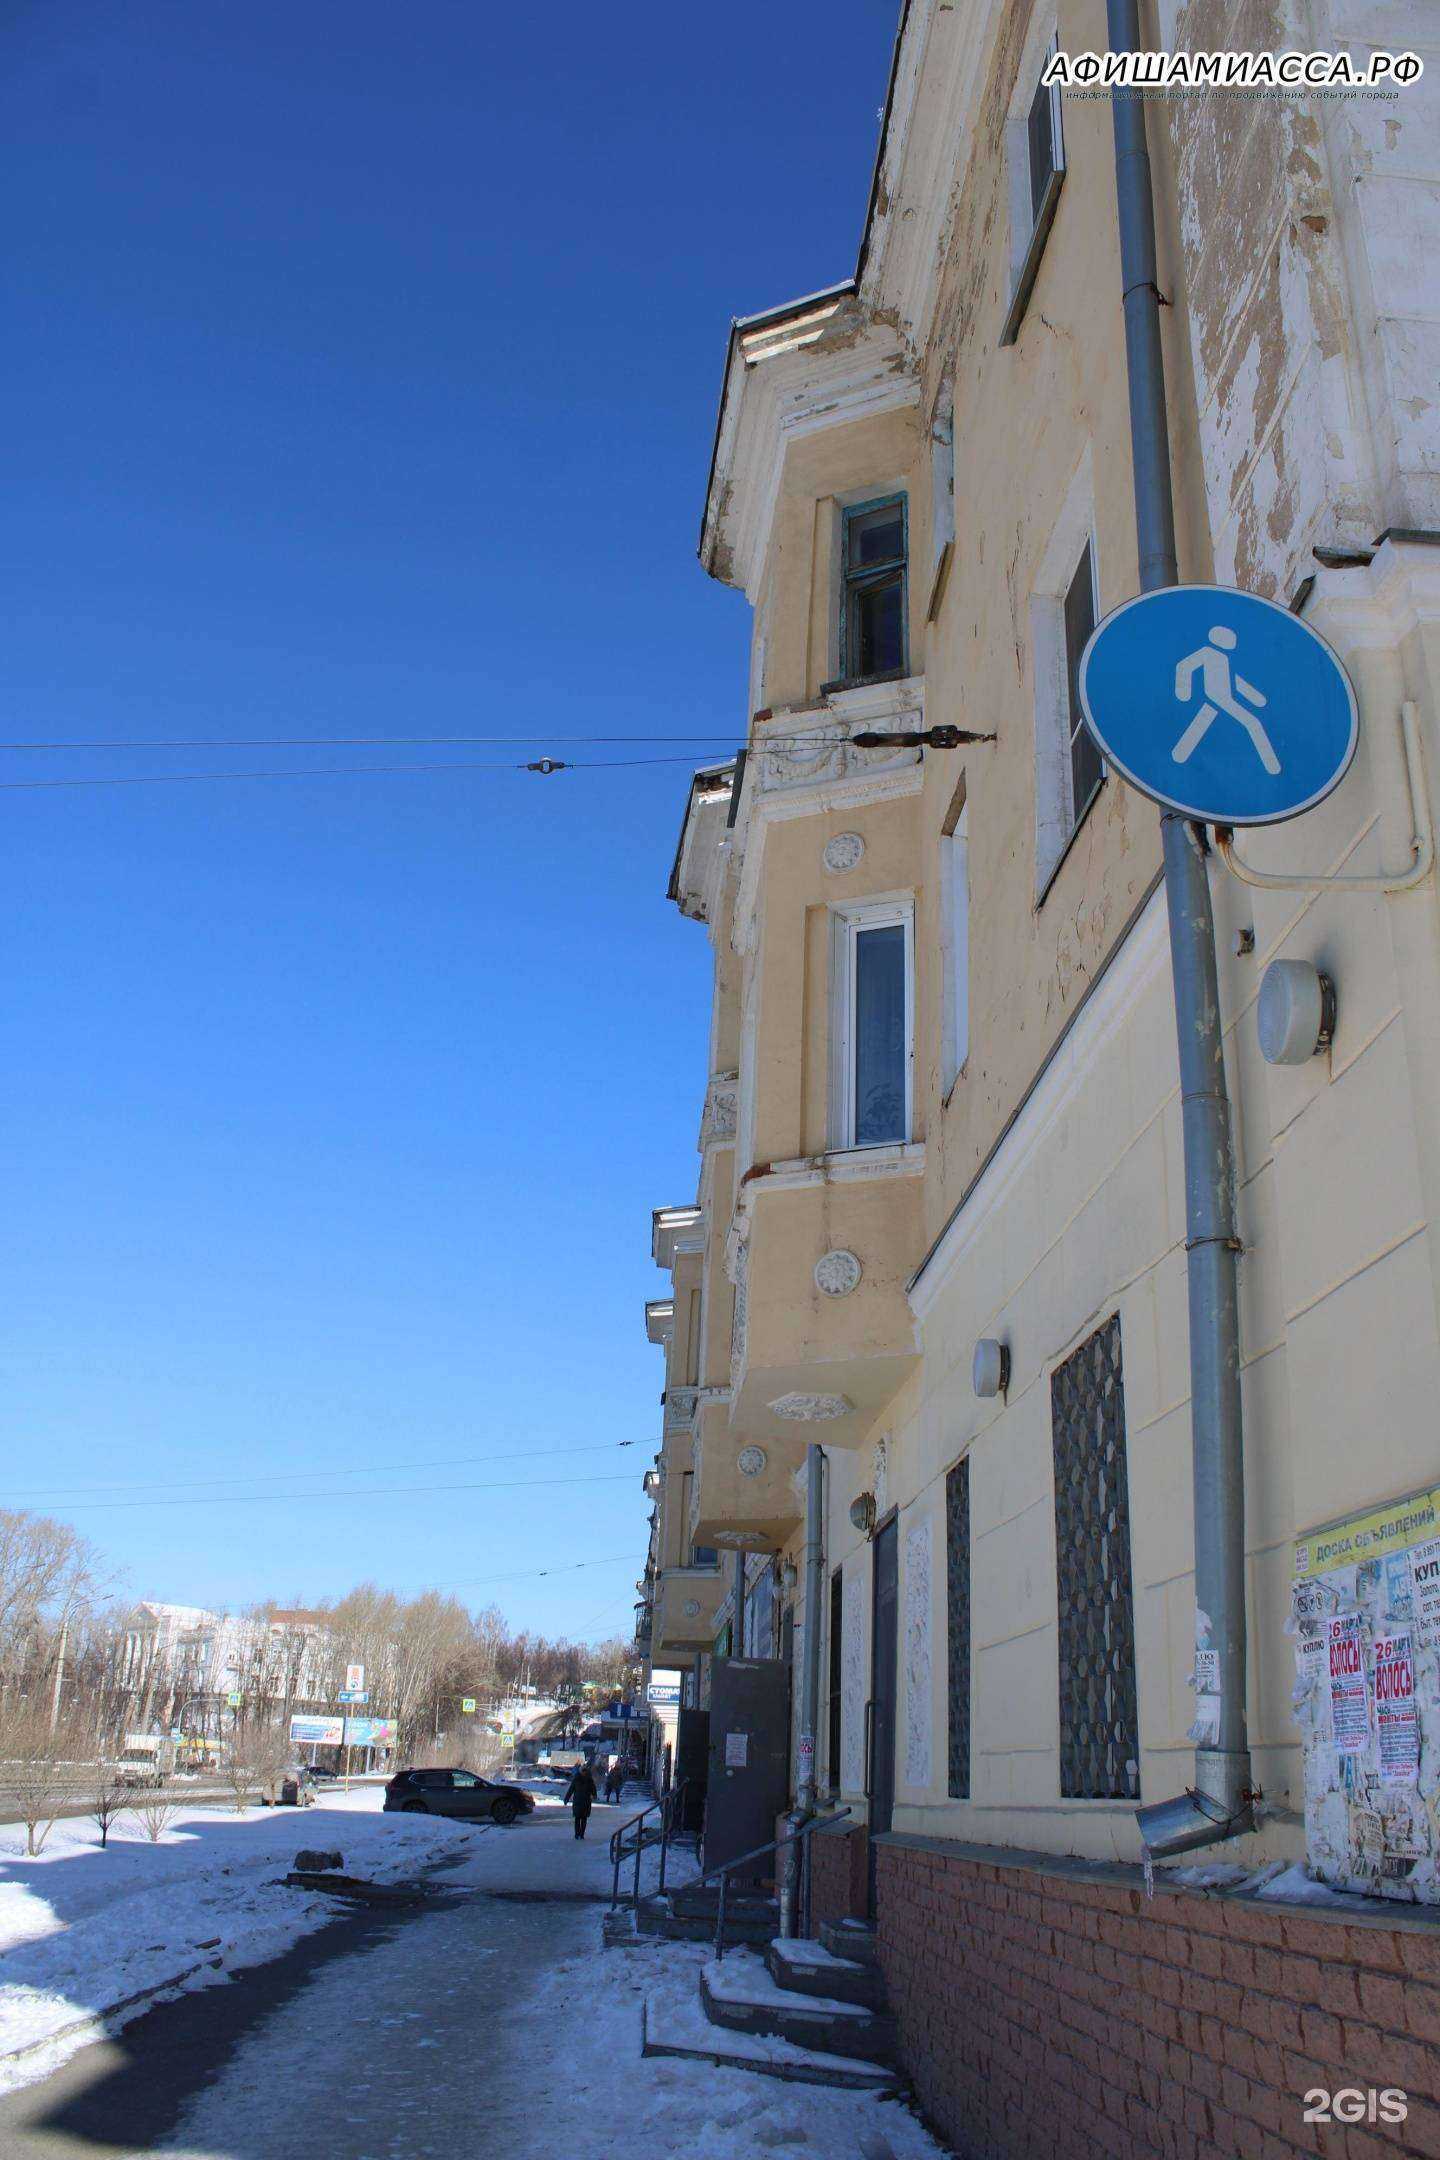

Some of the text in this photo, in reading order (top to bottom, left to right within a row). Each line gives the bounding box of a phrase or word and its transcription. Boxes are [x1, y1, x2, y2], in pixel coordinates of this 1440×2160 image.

[1317, 1538, 1352, 1562] ДОСКА
[1355, 1505, 1436, 1548] ОБЪЯВЛЕНИЙ
[1375, 1641, 1392, 1659] 26
[1376, 1660, 1412, 1700] ВОЛОСЫ
